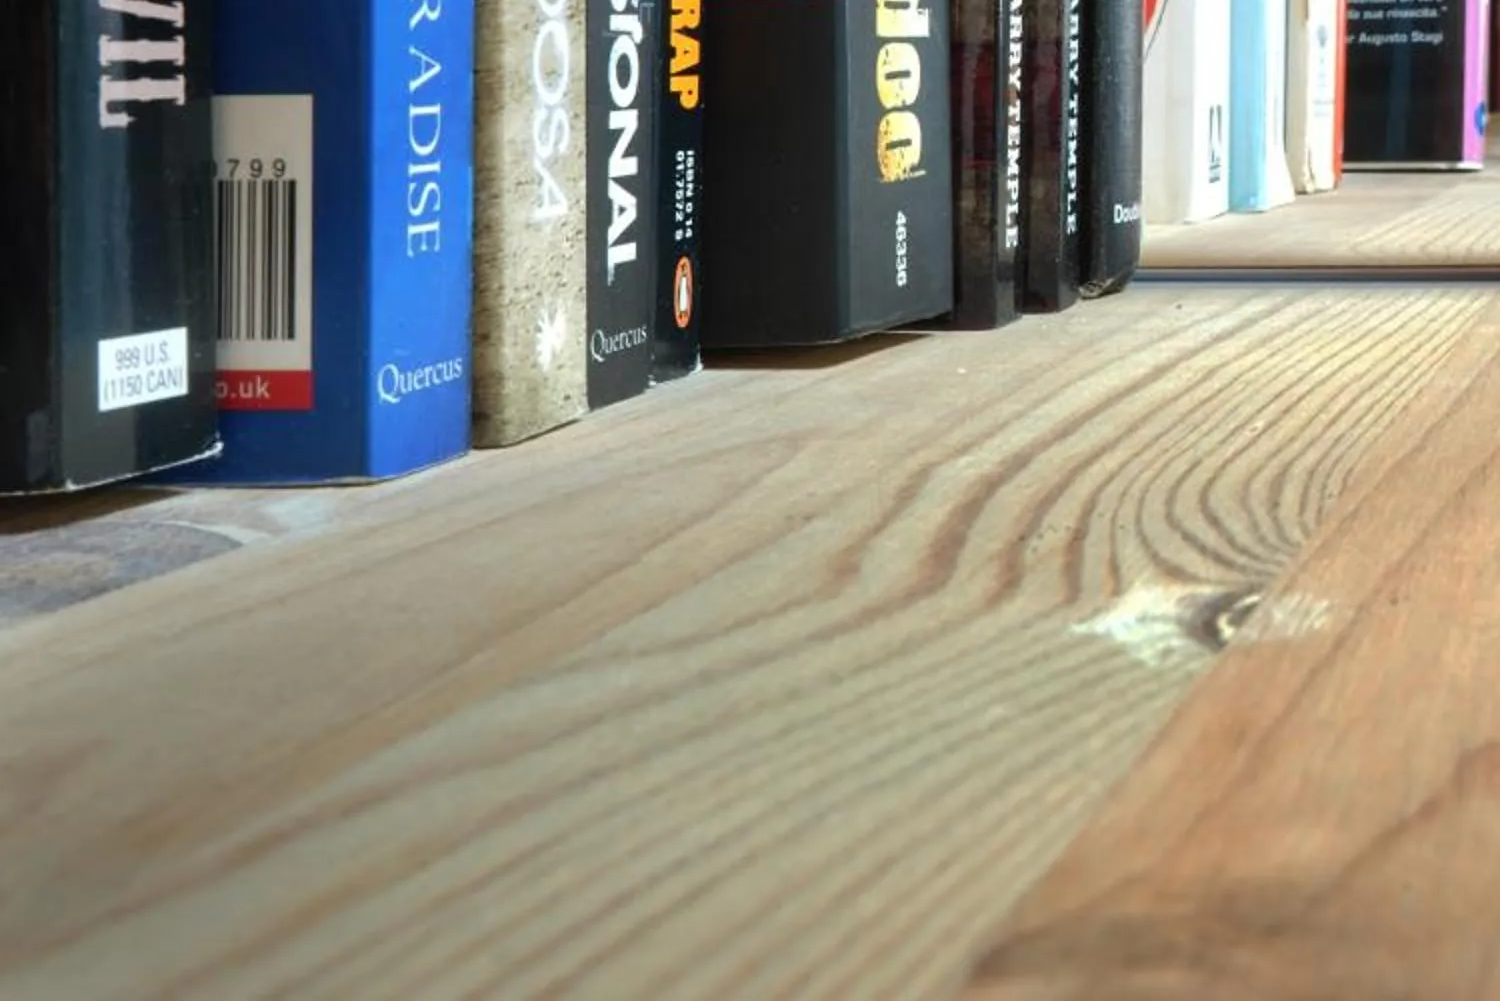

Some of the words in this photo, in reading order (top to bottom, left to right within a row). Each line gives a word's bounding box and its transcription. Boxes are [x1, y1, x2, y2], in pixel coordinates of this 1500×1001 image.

[1006, 98, 1022, 249] TEMPLE
[1066, 94, 1080, 235] TEMPLE
[377, 353, 464, 404] Quercus
[590, 324, 648, 363] Quercus
